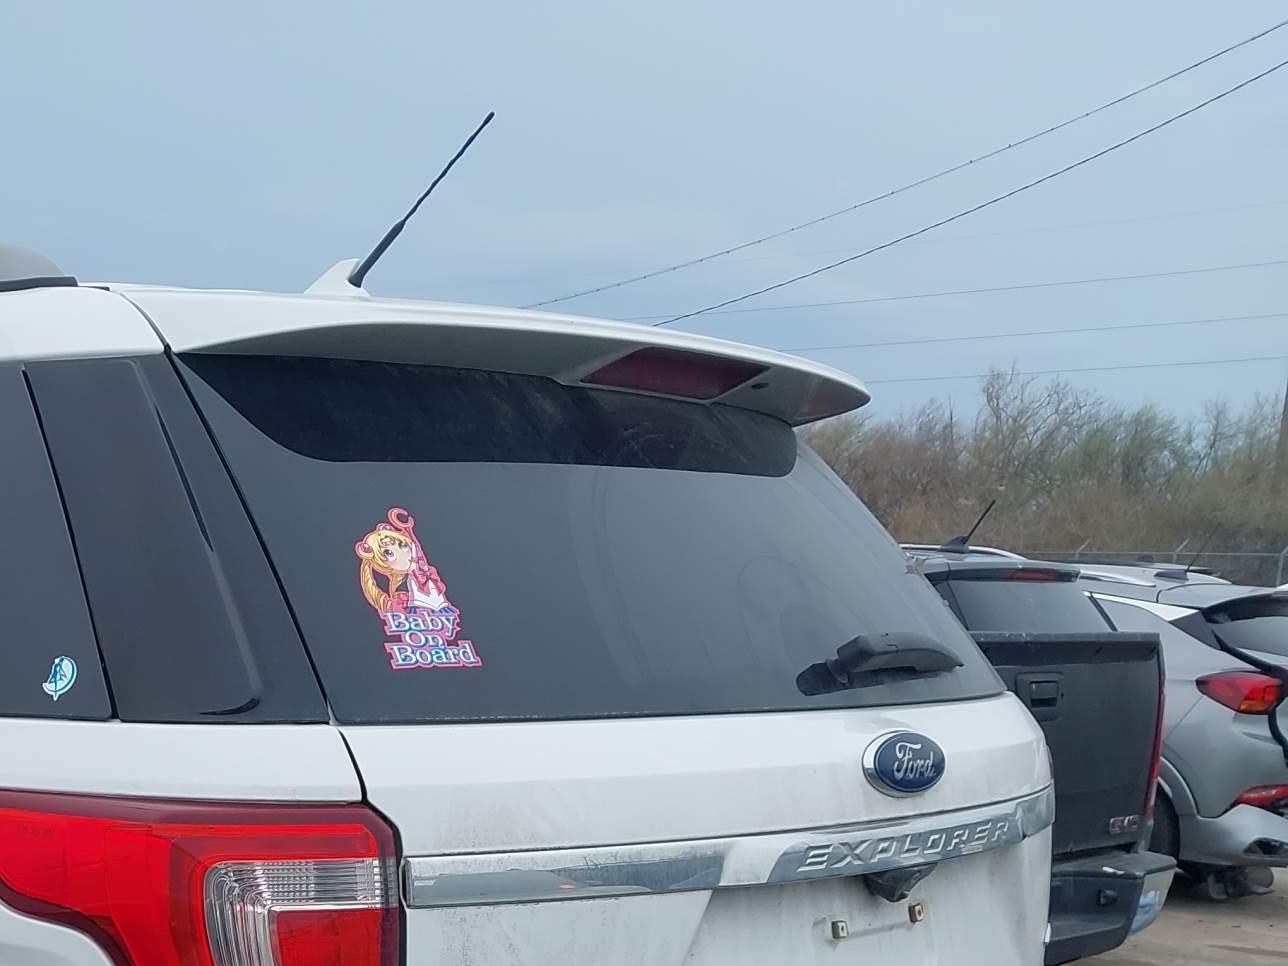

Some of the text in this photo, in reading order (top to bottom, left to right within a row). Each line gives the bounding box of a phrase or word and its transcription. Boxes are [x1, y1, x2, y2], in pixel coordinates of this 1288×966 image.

[387, 610, 456, 637] Baby
[404, 629, 445, 649] On
[391, 642, 478, 666] Board
[892, 741, 937, 781] Ford
[796, 821, 1010, 873] EXPLORER
